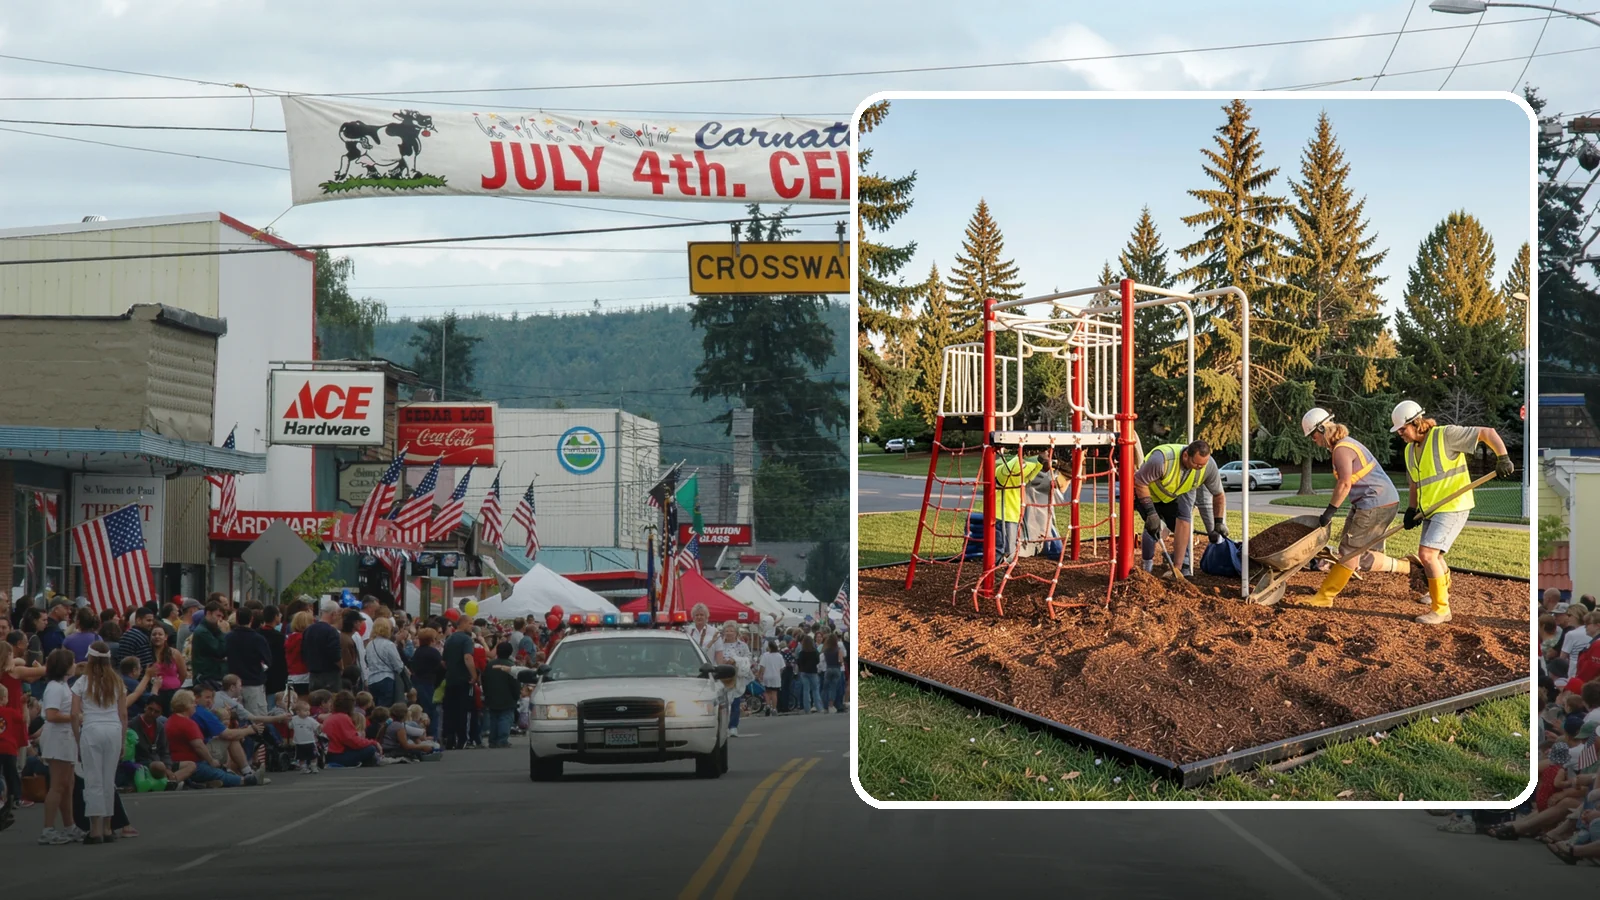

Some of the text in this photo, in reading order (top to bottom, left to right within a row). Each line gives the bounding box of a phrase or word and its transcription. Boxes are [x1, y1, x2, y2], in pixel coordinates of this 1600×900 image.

[481, 141, 605, 192] JULY
[632, 149, 746, 197] 4th.
[697, 254, 850, 280] CROSSWA
[282, 379, 373, 420] ACE
[406, 409, 451, 422] CEDAR
[283, 420, 370, 436] Hardware
[95, 485, 125, 495] Vincent
[126, 486, 136, 495] de
[137, 486, 155, 495] Paul
[81, 503, 154, 522] THT
[212, 516, 331, 536] HARDARE
[688, 526, 742, 535] CRNATION
[699, 535, 730, 543] GLASS
